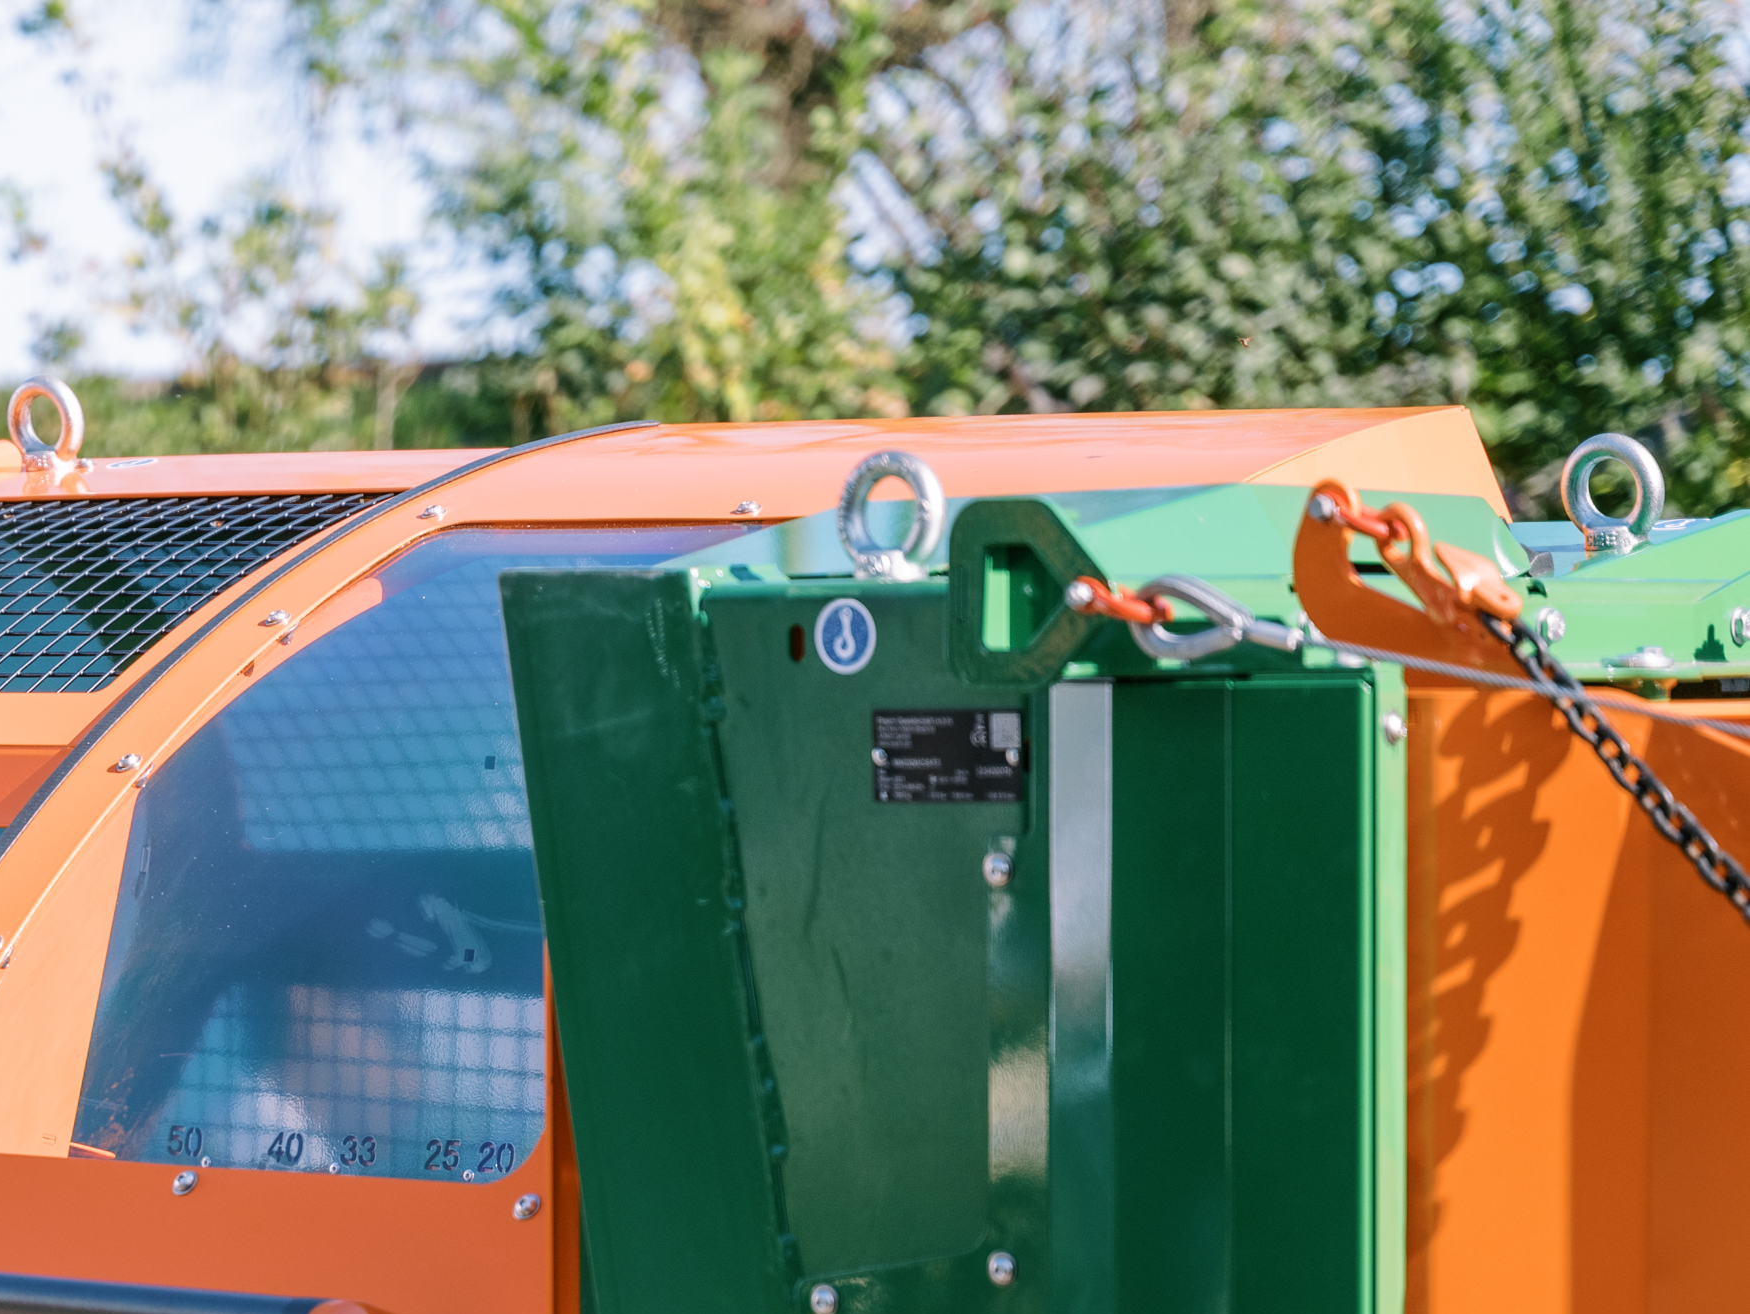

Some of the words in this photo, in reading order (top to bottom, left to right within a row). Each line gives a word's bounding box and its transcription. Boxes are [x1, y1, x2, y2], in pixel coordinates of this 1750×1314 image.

[166, 1125, 203, 1157] 50
[267, 1131, 304, 1163] 40
[339, 1135, 377, 1167] 33
[424, 1138, 462, 1172] 25
[476, 1141, 515, 1174] 20
